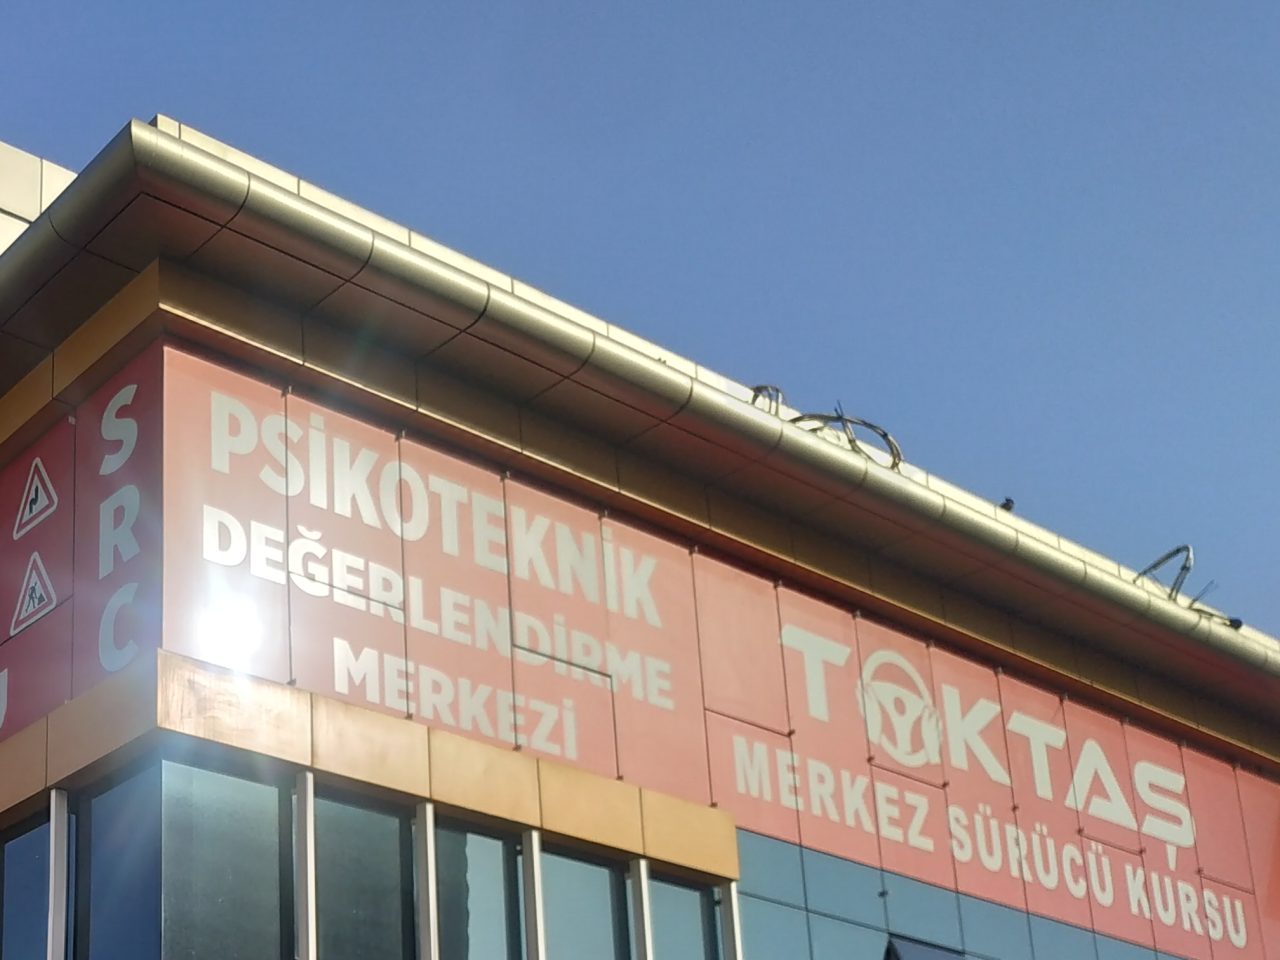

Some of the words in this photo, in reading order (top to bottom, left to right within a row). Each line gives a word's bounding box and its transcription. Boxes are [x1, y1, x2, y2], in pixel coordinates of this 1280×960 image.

[98, 384, 139, 673] SRC
[202, 504, 675, 710] DEĞERLENDİRME
[210, 391, 662, 628] PSİKOTEKNİK
[333, 637, 579, 761] MERKEZİ
[732, 735, 935, 853] MERKEZ
[949, 803, 1115, 907] SÜRÜCÜ
[1124, 863, 1248, 949] KURSU
